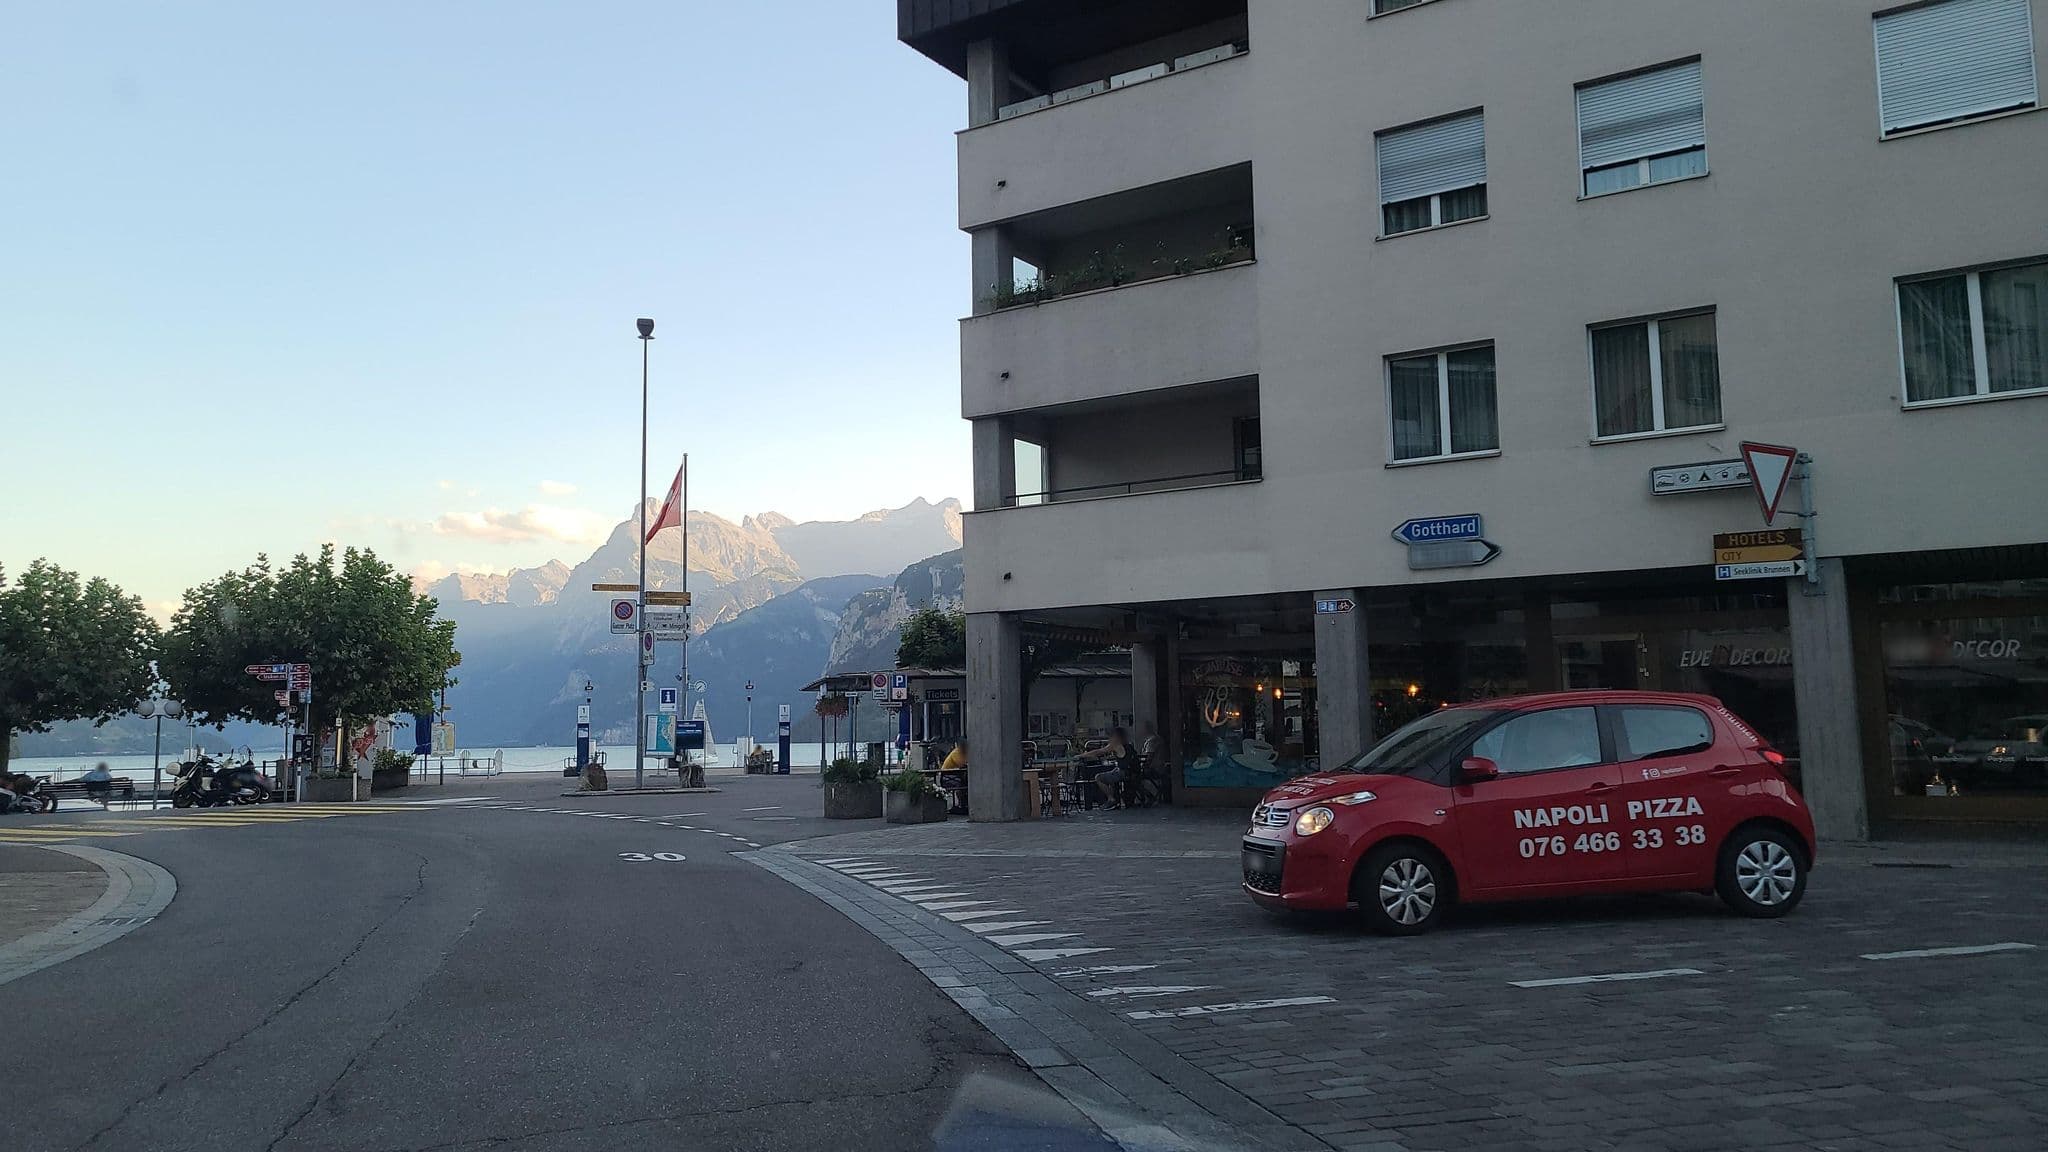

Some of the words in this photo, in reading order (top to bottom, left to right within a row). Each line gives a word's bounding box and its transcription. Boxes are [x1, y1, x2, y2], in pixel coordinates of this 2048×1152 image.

[1411, 519, 1476, 537] Gotthard
[1728, 531, 1786, 546] HOTELS
[1721, 551, 1742, 561] CITY
[1733, 567, 1762, 576] Seeklinik
[1764, 565, 1791, 574] Brunnen
[1952, 639, 2021, 658] DECOR
[1729, 648, 1790, 666] DECOR
[895, 675, 904, 687] P
[926, 690, 959, 699] Tickets
[1513, 804, 1610, 829] NAPOLI
[1627, 796, 1705, 820] PIZZA
[1519, 835, 1567, 858] 076
[1573, 831, 1621, 853] 466
[1632, 828, 1664, 849] 33
[1675, 824, 1706, 846] 38
[618, 852, 686, 861] 30
